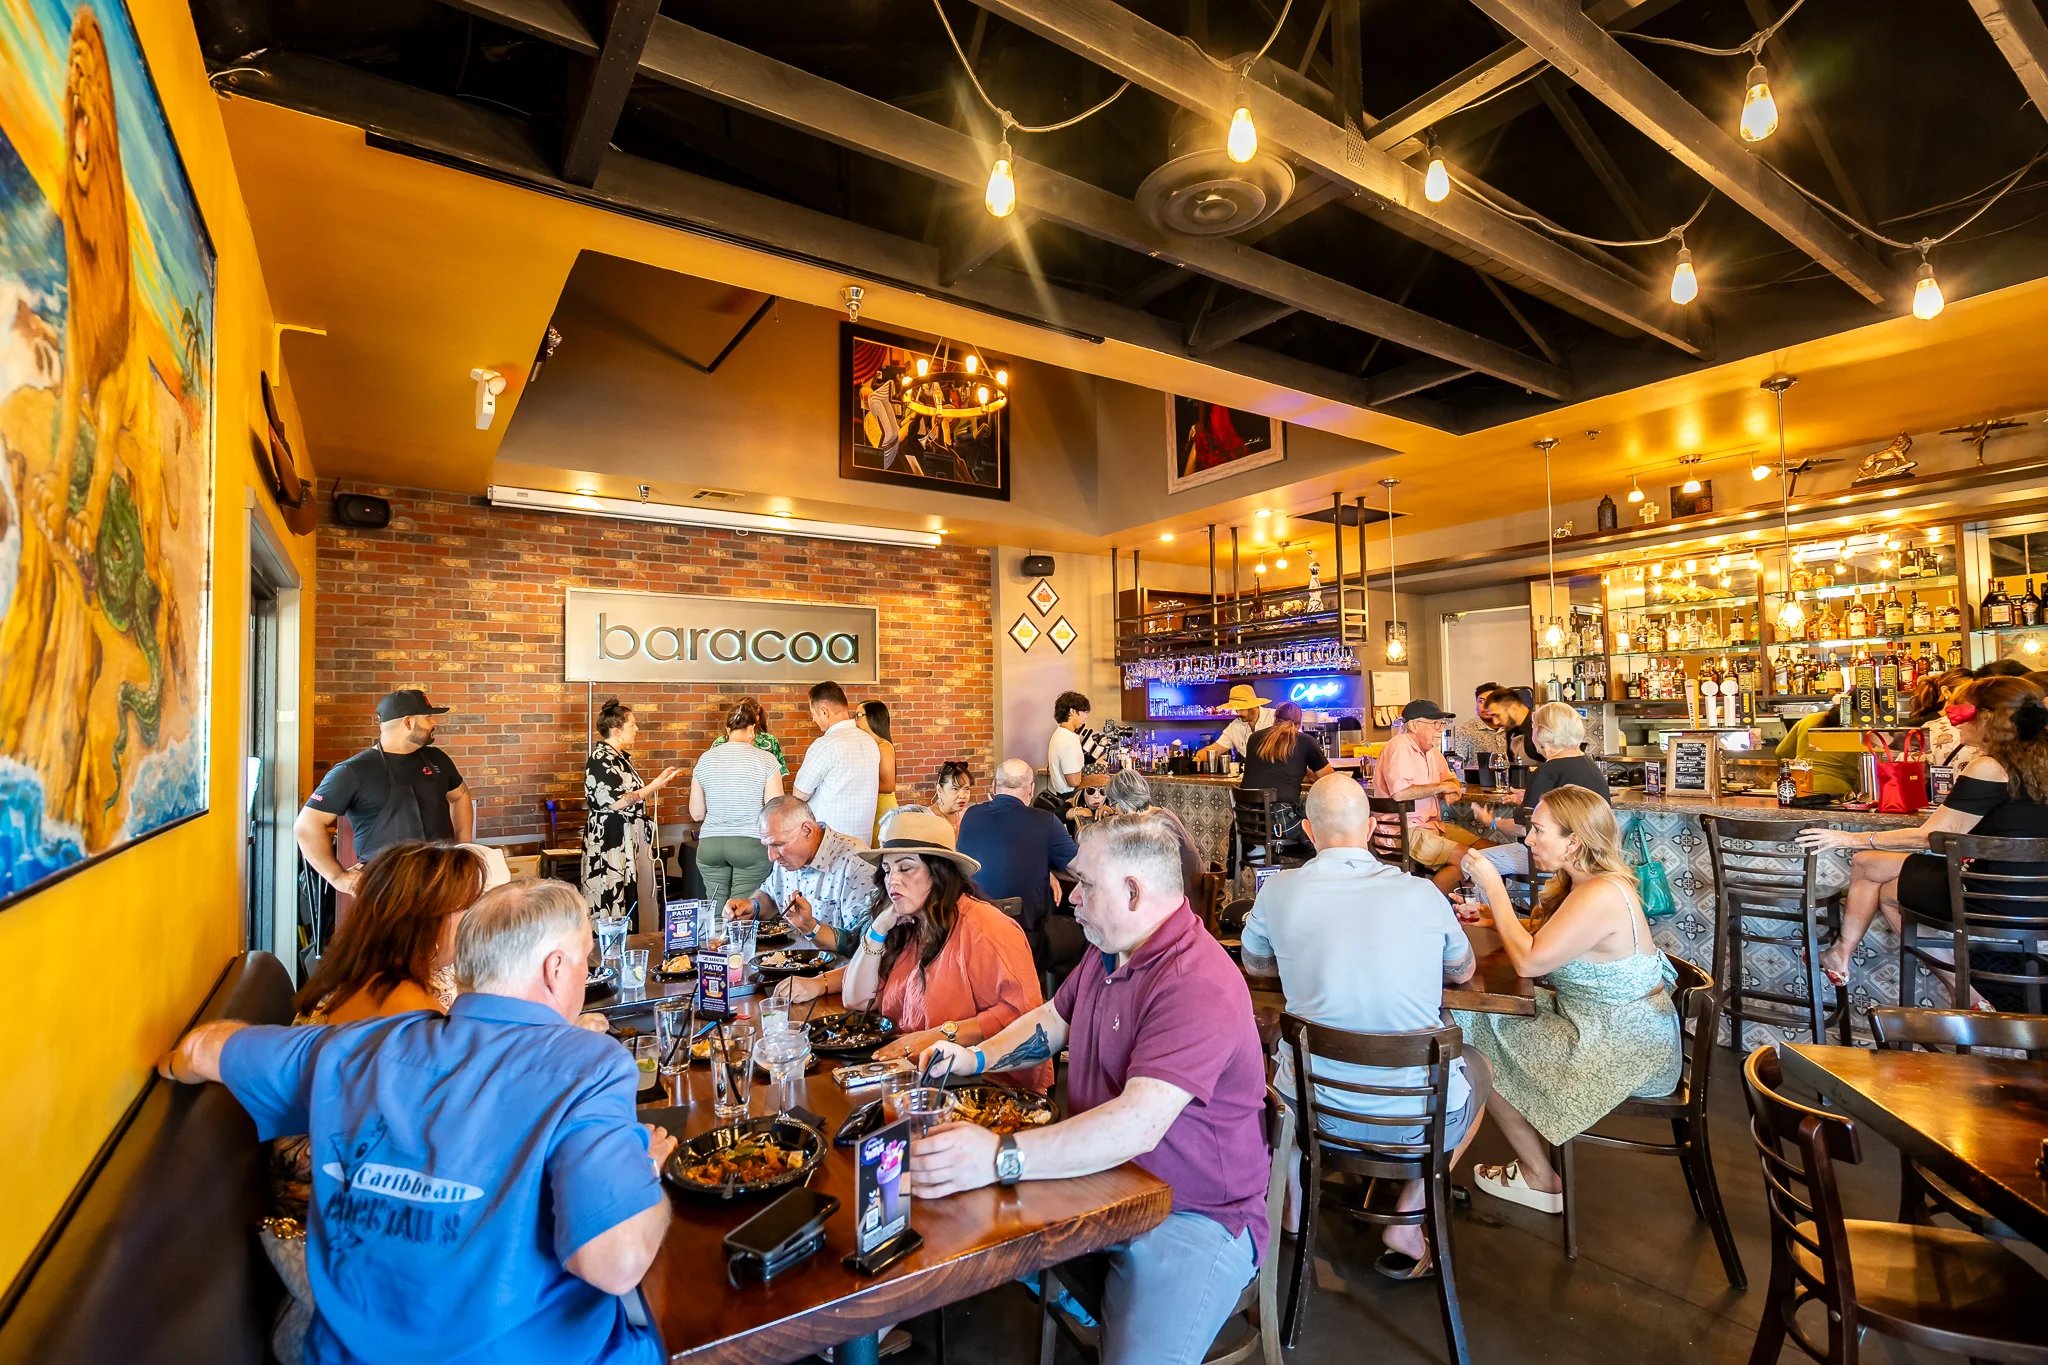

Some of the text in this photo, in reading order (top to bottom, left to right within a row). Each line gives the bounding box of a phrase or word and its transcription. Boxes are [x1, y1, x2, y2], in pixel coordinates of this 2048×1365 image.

[597, 612, 859, 664] baracoa
[1860, 689, 1871, 709] KÖBI
[704, 963, 723, 971] PATIO
[356, 1166, 468, 1201] Caribbean
